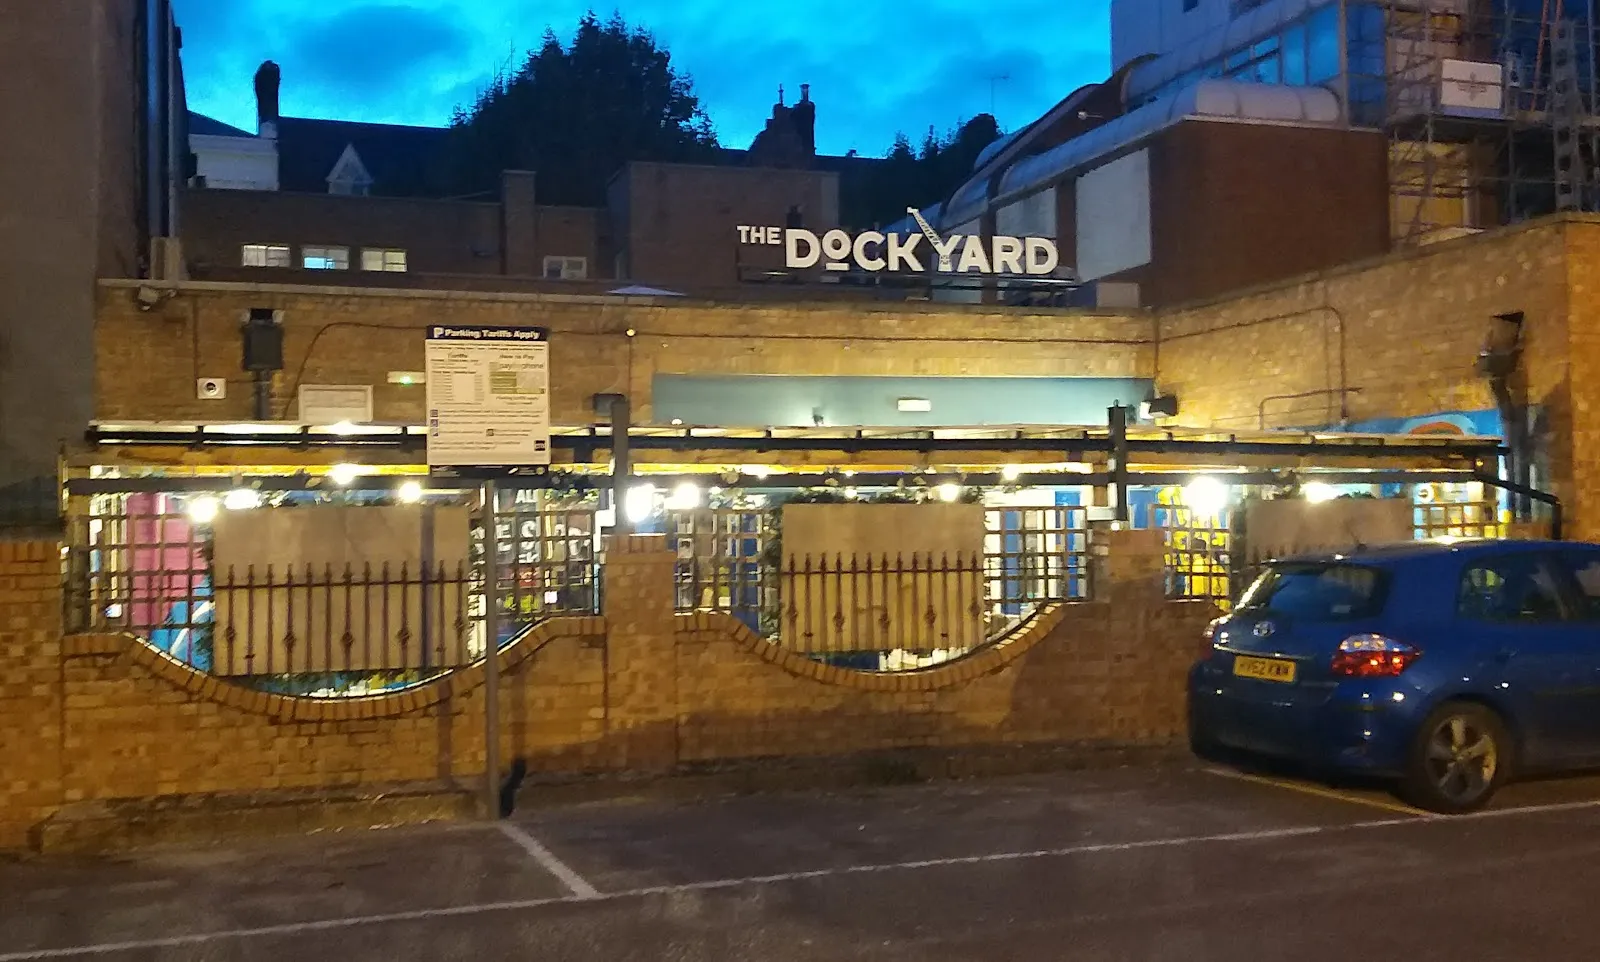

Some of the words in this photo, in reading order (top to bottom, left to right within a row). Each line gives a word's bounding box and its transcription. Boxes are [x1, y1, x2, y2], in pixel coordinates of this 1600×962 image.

[736, 225, 782, 246] THE
[785, 219, 1060, 276] DOCKYARD
[445, 328, 481, 339] Parking
[482, 329, 512, 338] Tariffs
[513, 330, 540, 340] Apply
